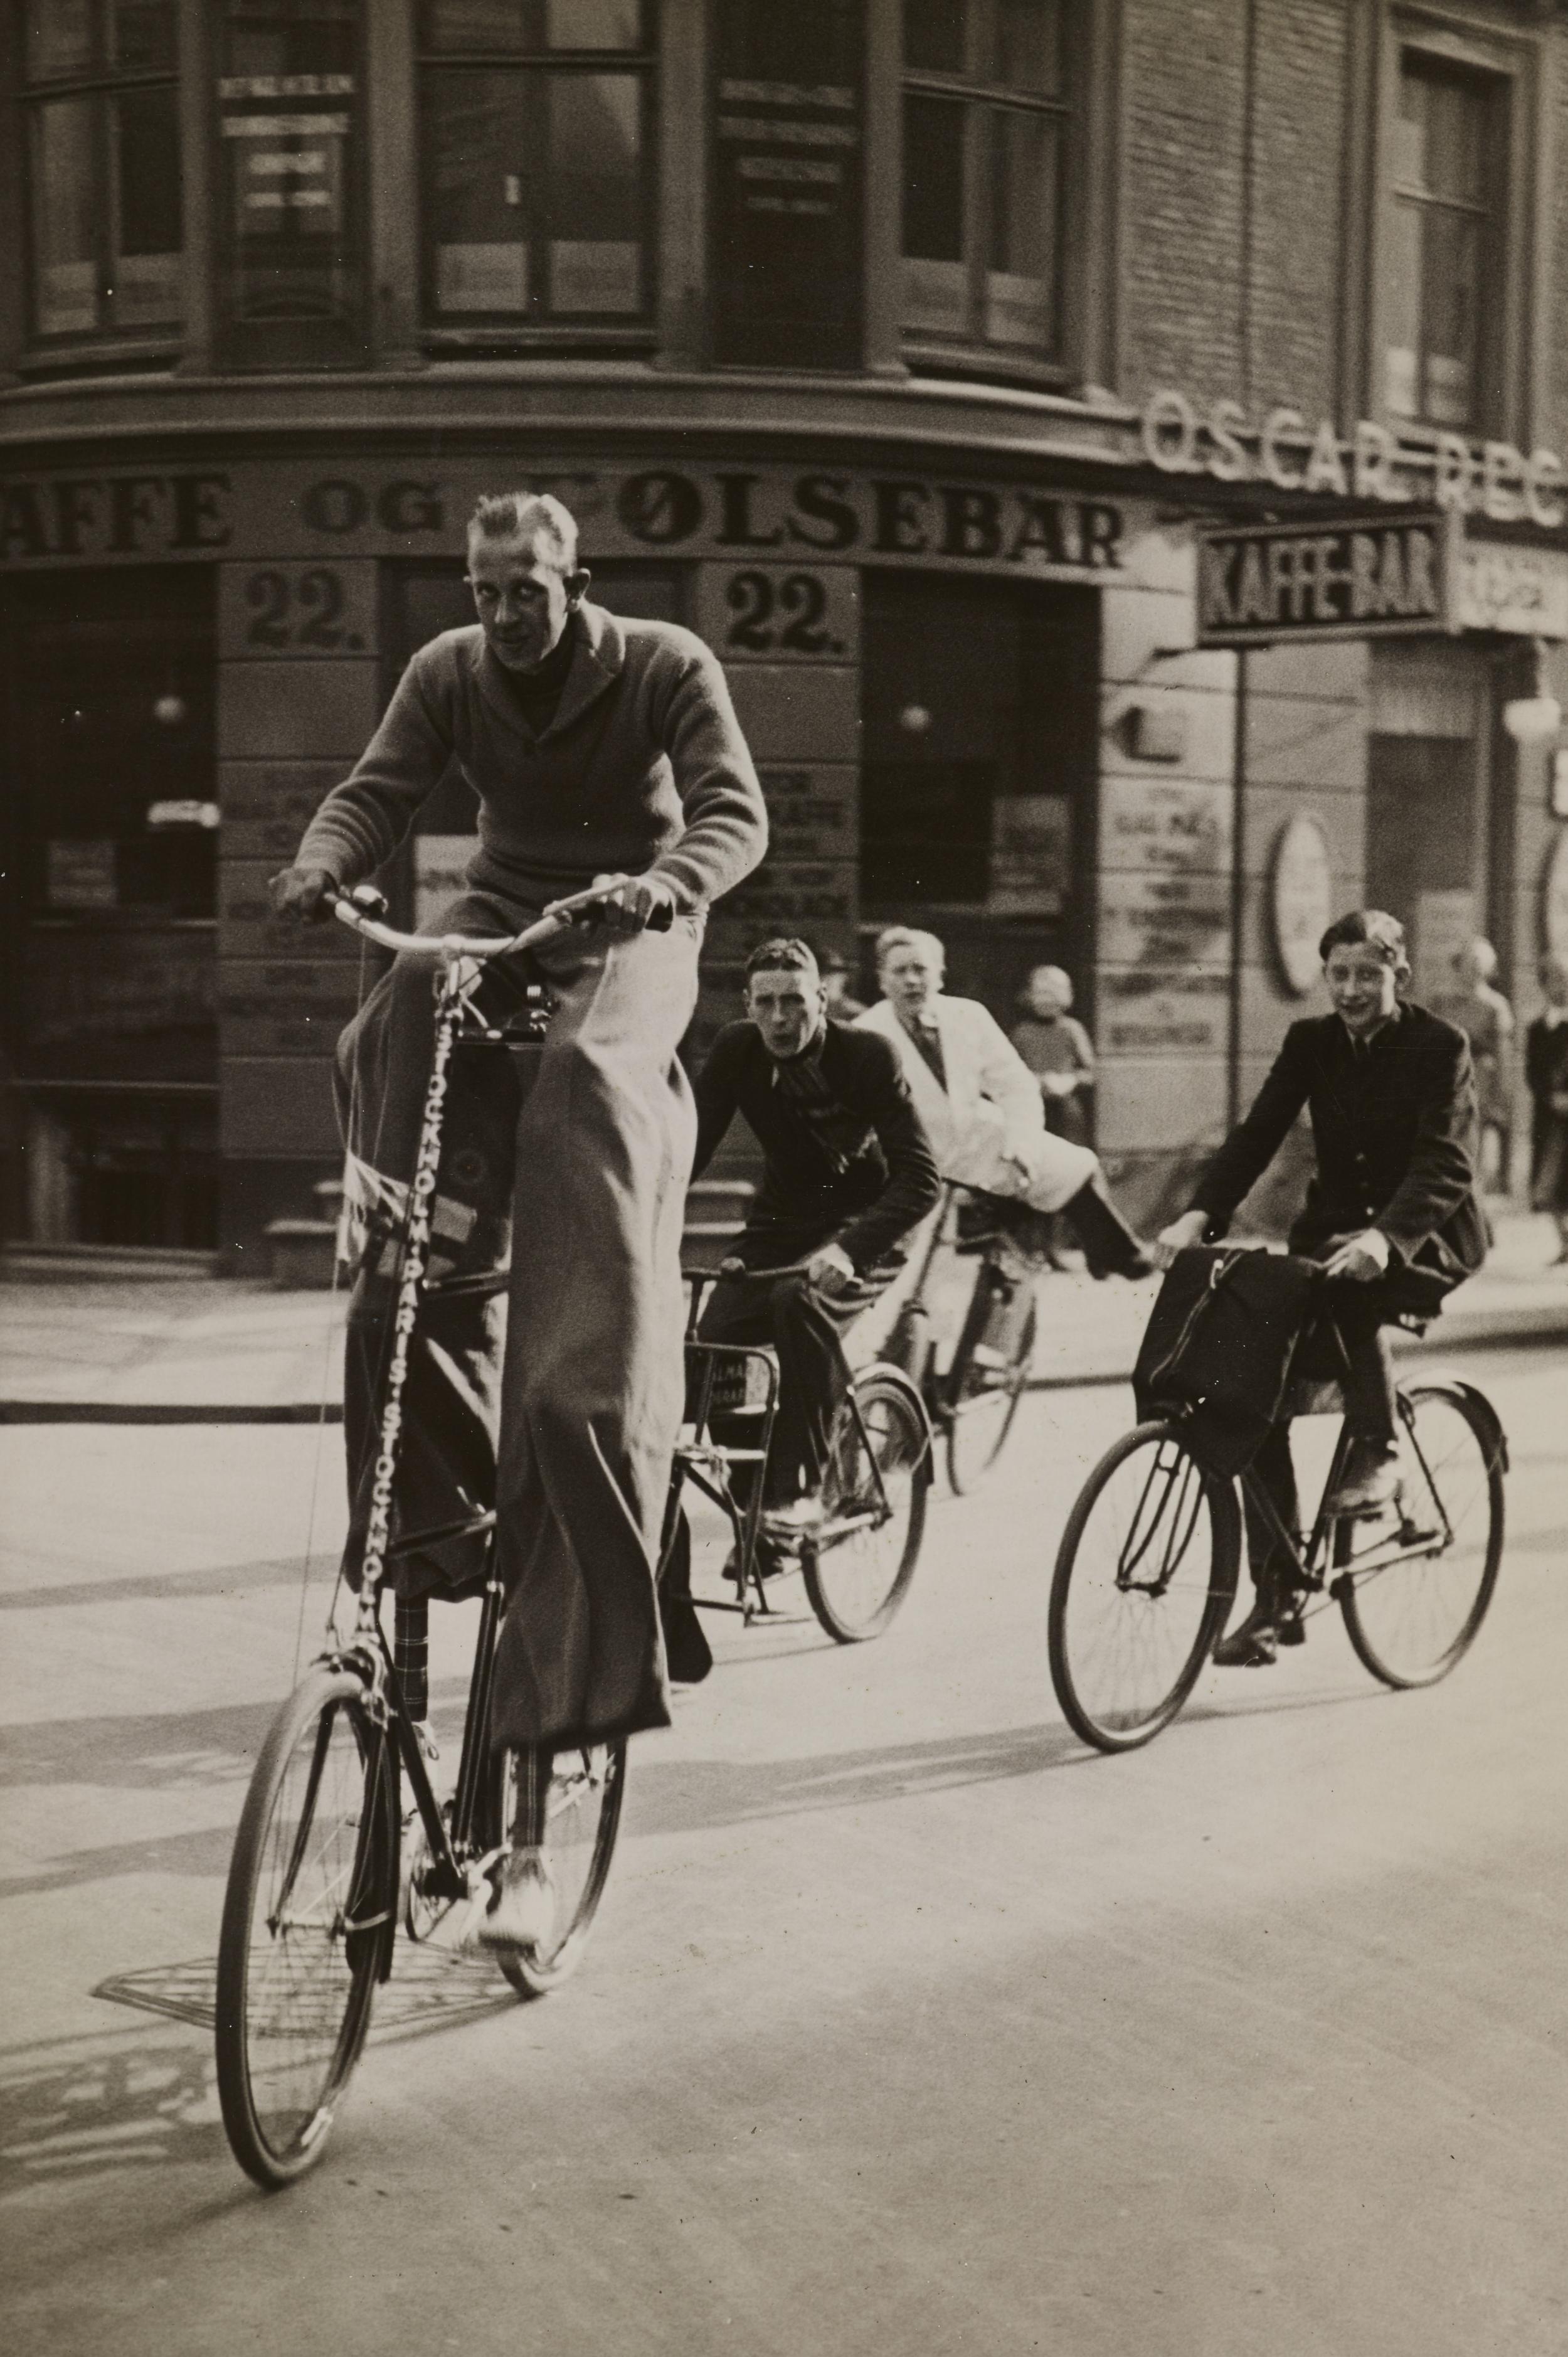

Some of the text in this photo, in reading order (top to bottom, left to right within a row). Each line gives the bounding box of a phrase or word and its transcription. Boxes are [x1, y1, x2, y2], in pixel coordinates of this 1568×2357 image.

[1145, 389, 1402, 501] OSCAR
[302, 478, 443, 533] OG
[528, 471, 1125, 570] ØLSEBAR
[245, 568, 364, 651] 22.
[726, 571, 843, 653] 22.
[356, 1024, 453, 1632] STOCKHOLM PARIS STOCKHOLM
